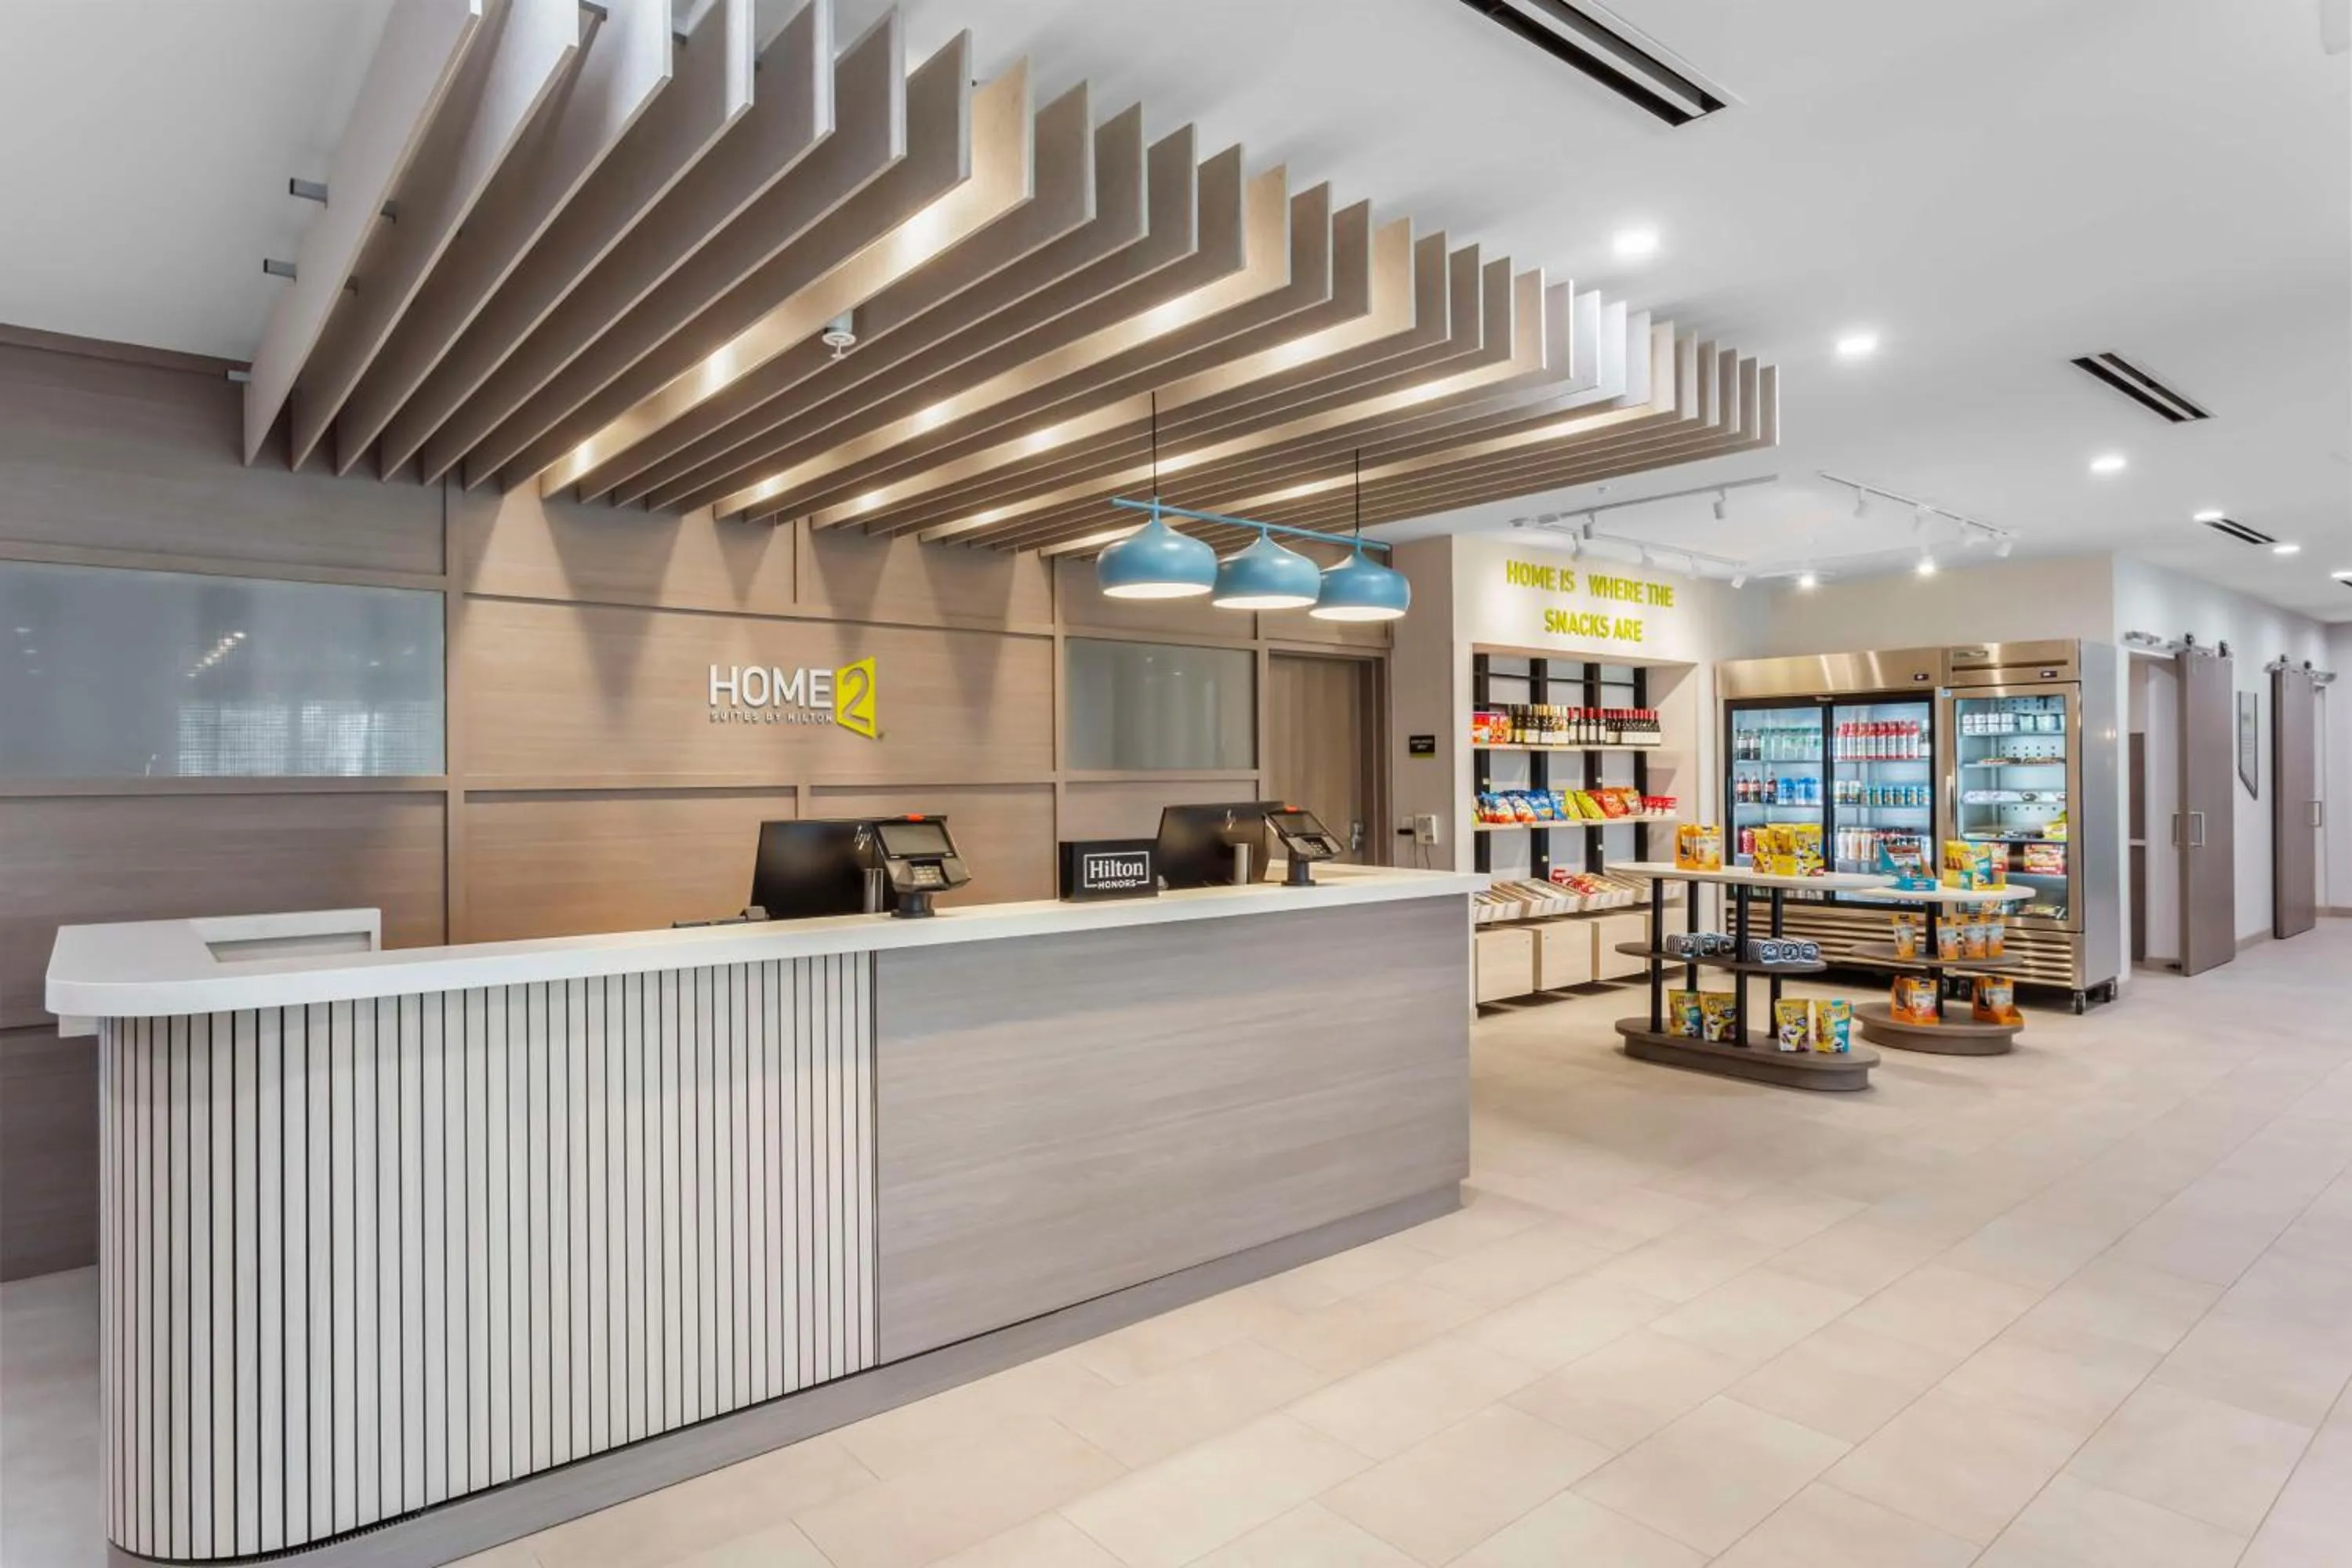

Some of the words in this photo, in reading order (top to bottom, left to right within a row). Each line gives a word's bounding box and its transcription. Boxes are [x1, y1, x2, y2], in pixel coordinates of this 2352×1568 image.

[1506, 560, 1556, 590] HOME
[1559, 568, 1576, 592] IS
[1588, 574, 1643, 604] WHERE
[1646, 583, 1674, 608] THE
[1544, 608, 1610, 638] SNACKS
[1613, 618, 1643, 642] ARE
[710, 664, 833, 707] HOME
[841, 666, 871, 730] 2
[710, 710, 757, 723] SUITES
[787, 712, 833, 724] HILTON
[1089, 859, 1144, 879] Hilton
[1098, 879, 1137, 889] HONORS
